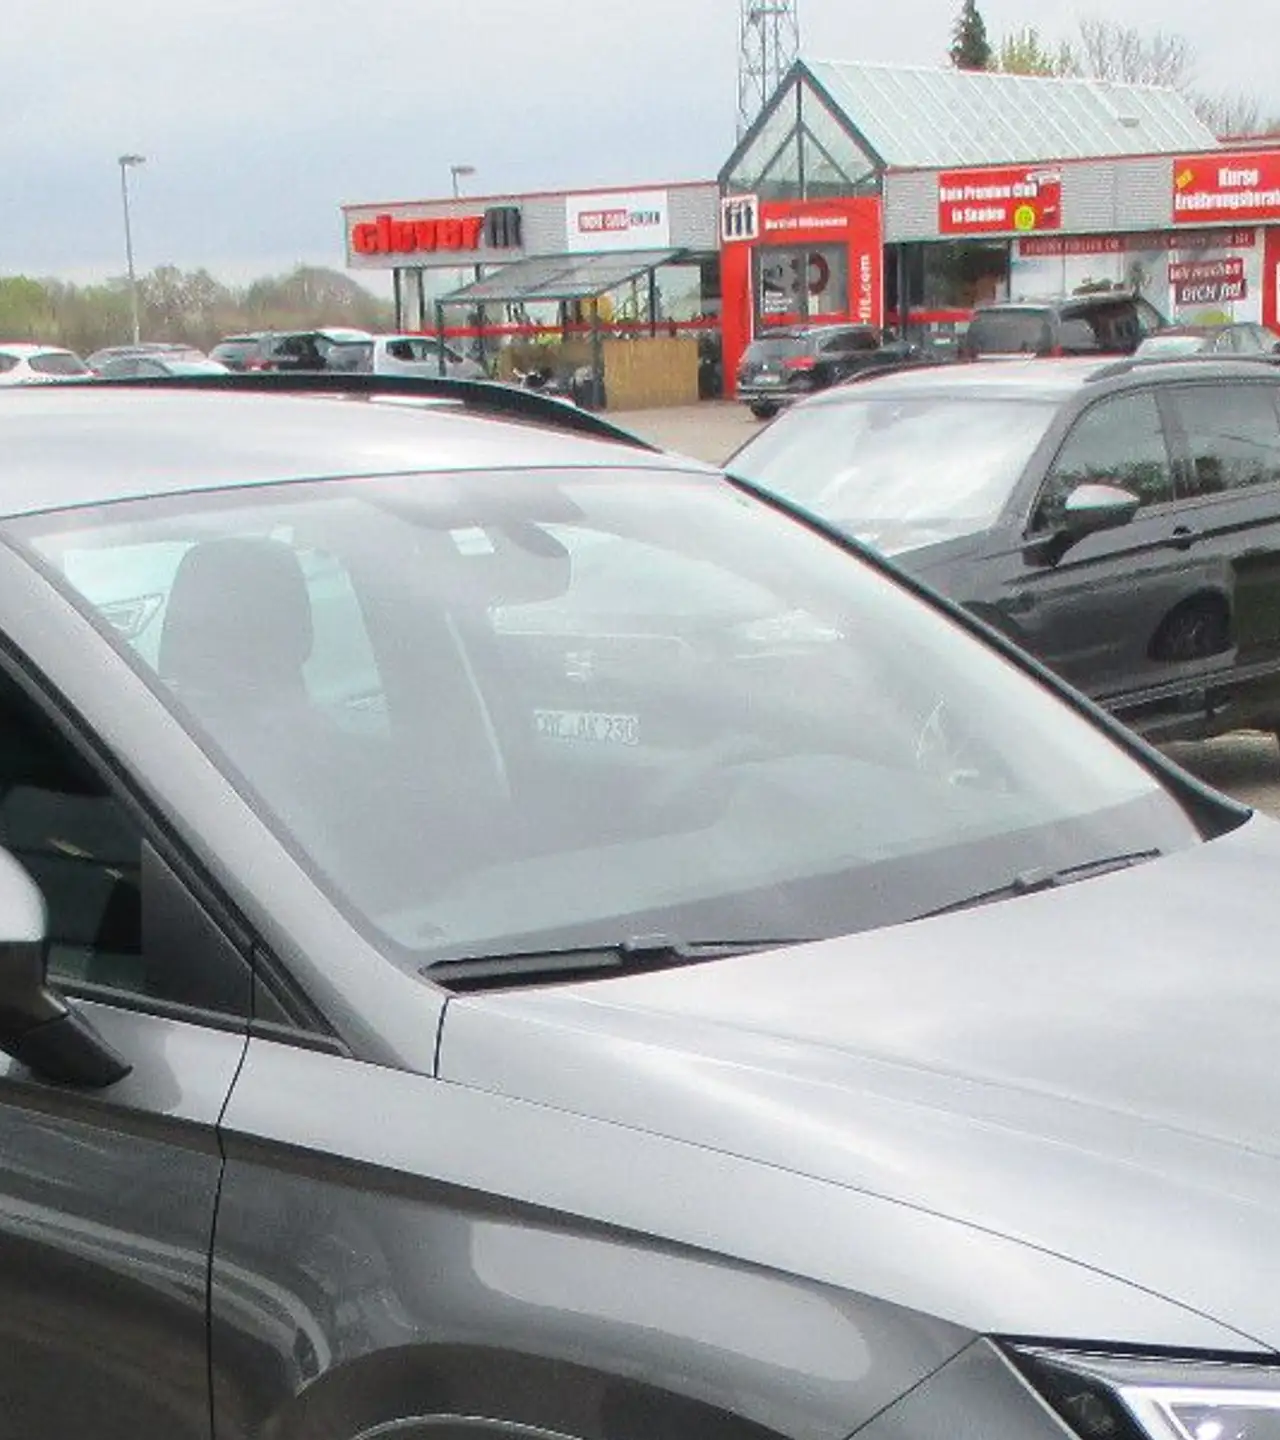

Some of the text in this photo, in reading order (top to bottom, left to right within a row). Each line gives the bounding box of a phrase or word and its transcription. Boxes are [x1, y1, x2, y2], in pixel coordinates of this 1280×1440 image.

[1217, 168, 1259, 187] Kurse
[964, 185, 1011, 200] Premium
[352, 205, 521, 255] clever fit
